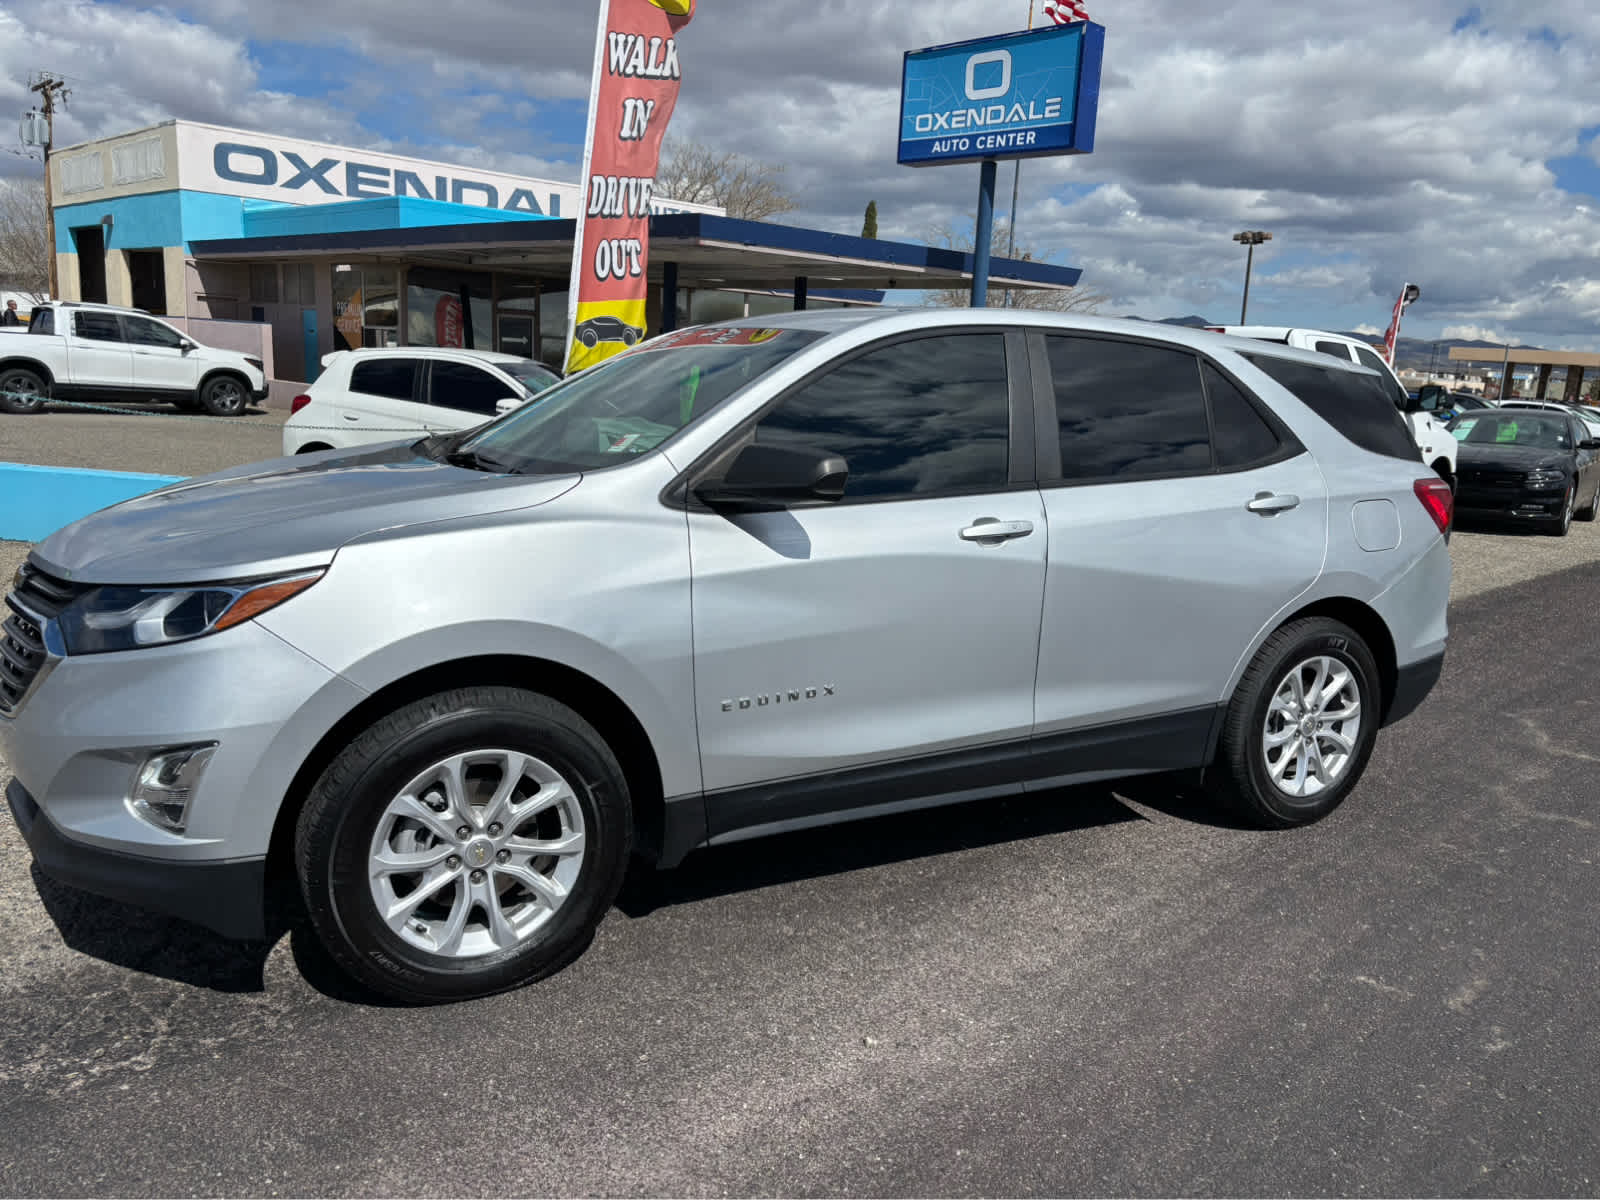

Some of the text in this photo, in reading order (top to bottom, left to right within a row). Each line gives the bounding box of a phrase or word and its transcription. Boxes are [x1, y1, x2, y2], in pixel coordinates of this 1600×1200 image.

[608, 31, 681, 80] WALK
[620, 98, 654, 141] IN
[915, 97, 1062, 133] OXENDALE
[931, 131, 1036, 153] AUTO CENTER
[213, 142, 561, 218] OXENDAL
[588, 175, 654, 218] DRIVE
[594, 238, 642, 280] OUT
[721, 683, 835, 712] EQUINOX
